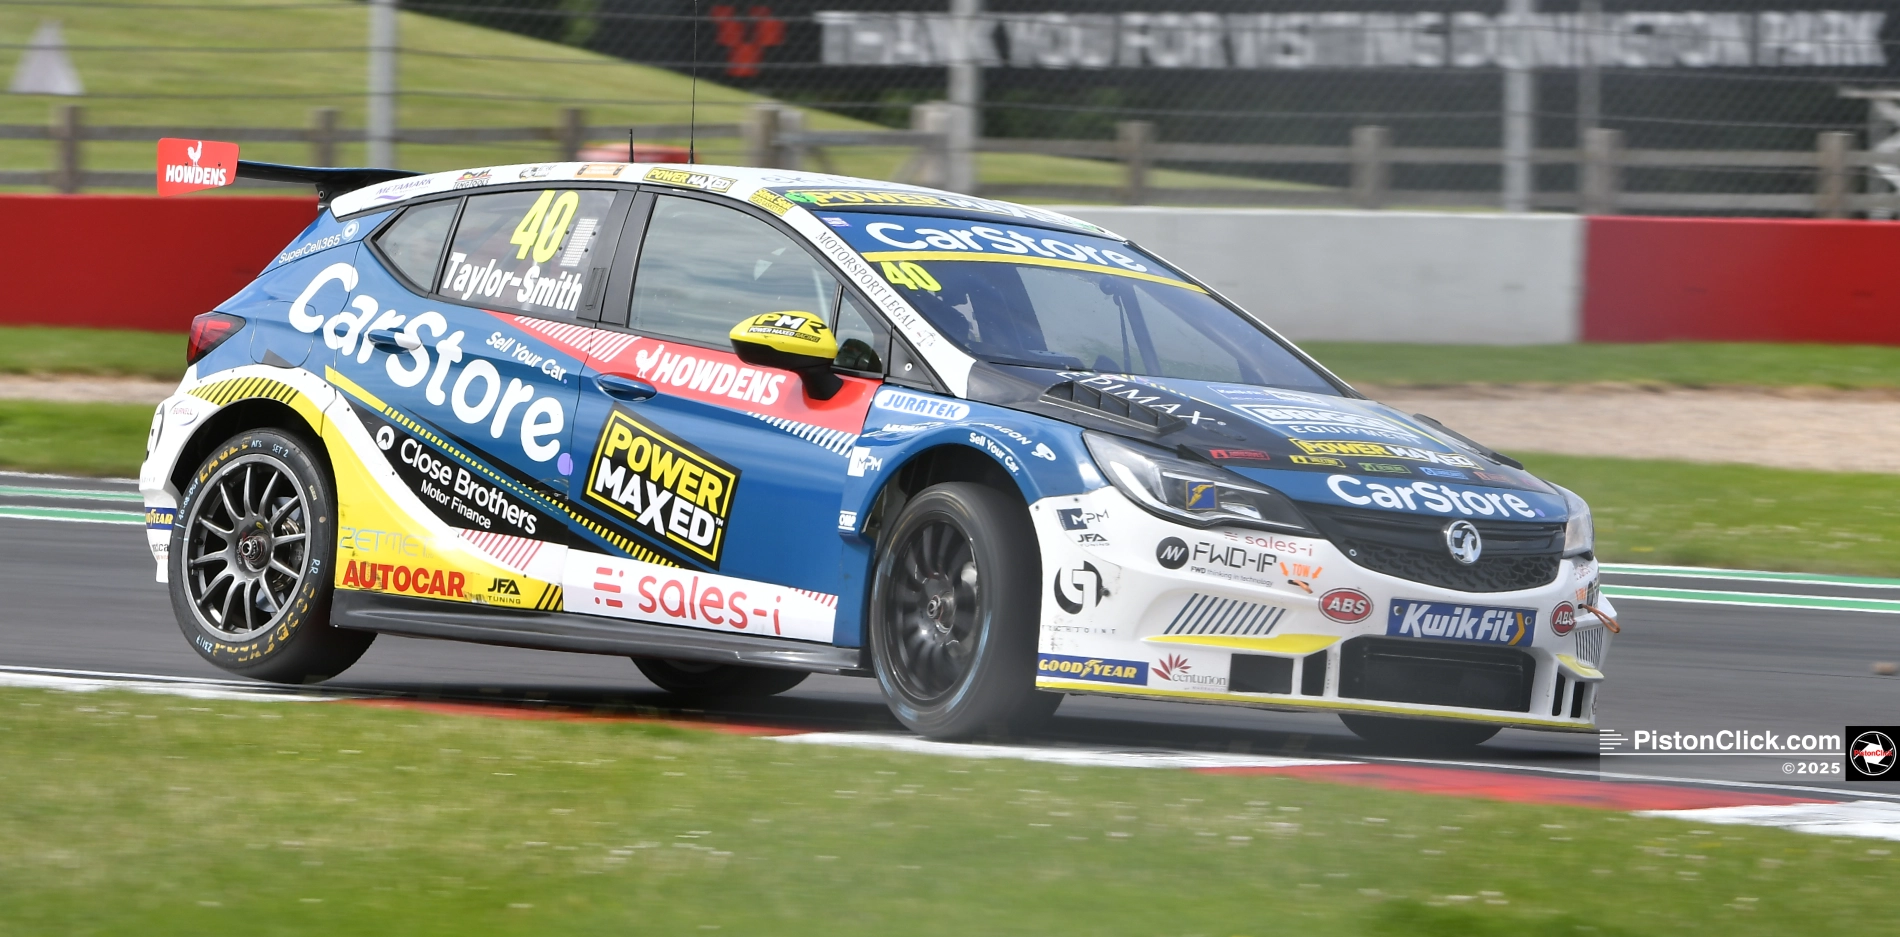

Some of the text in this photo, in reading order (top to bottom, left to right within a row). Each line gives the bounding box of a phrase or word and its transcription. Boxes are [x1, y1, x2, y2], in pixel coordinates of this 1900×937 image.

[814, 11, 999, 66] THANK
[1005, 11, 1112, 68] YOU
[1118, 12, 1225, 67] FOR
[1754, 12, 1886, 67] PARK
[166, 164, 226, 186] HOWDENS
[648, 169, 731, 190] POWER MAXED
[755, 189, 778, 203] Steel
[774, 197, 795, 210] Seal
[510, 189, 579, 264] 40
[278, 233, 342, 265] SuperCell365
[866, 222, 1147, 273] CarStore
[443, 252, 584, 312] Taylor-Smith
[816, 231, 887, 297] MOTORSPORT
[880, 295, 917, 331] LEGAL
[880, 262, 942, 293] 40
[748, 326, 820, 342] POWER MAXED RACING
[755, 313, 828, 335] PMR
[485, 331, 511, 352] Sell
[509, 340, 543, 371] Your
[652, 352, 786, 405] HOWDENS
[884, 394, 960, 418] JURATEK
[969, 432, 986, 447] Sell
[986, 438, 1007, 459] Your
[1288, 425, 1422, 445] EQUIPMENT
[272, 443, 284, 455] SET
[282, 448, 290, 459] 2
[1301, 439, 1392, 456] POWER
[1384, 445, 1478, 468] MAXED
[604, 423, 724, 514] POWER
[399, 436, 538, 536] Close Brothers
[420, 479, 493, 530] Motor Finance
[594, 457, 716, 548] MAXED
[1070, 508, 1110, 525] MPM
[1077, 533, 1109, 543] JFA
[1245, 535, 1313, 557] sales-i
[1192, 541, 1278, 573] FWD-IP
[342, 559, 466, 598] AUTOCAR
[1190, 565, 1275, 588] FWD thinking in technology
[1292, 562, 1311, 578] TOW
[487, 577, 521, 596] JFA
[488, 595, 521, 605] TUNING
[637, 574, 782, 637] sales-i
[1327, 597, 1367, 616] ABS
[1554, 610, 1575, 626] ABS
[1038, 658, 1138, 680] GOODYEAR
[1171, 673, 1227, 686] centurion
